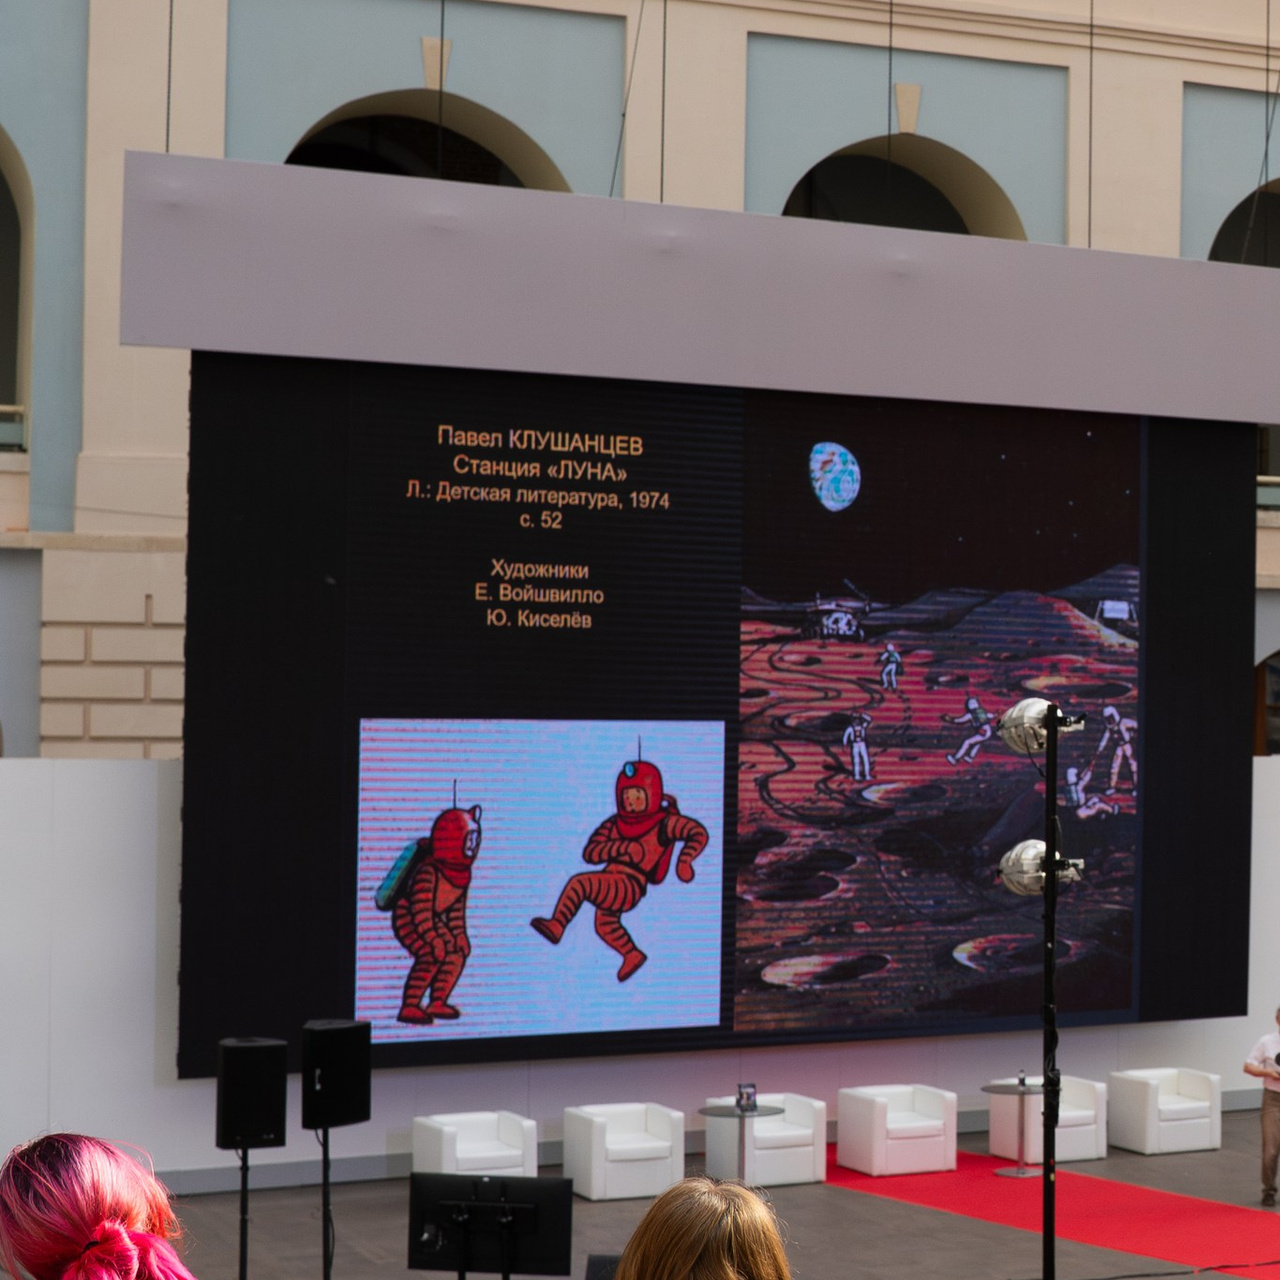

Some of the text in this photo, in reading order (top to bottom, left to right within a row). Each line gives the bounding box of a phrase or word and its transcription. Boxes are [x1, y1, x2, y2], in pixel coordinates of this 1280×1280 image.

[438, 425, 643, 458] Павел КЛУШАНЦЕВ
[453, 454, 627, 482] Станция «ЛУНА»
[407, 480, 669, 510] Л.: Детская литература, 1974
[520, 511, 562, 529] с. 52
[491, 559, 588, 580] Художники
[475, 583, 604, 604] Е. Войшвилло
[487, 609, 591, 629] Ю. Киселёв
